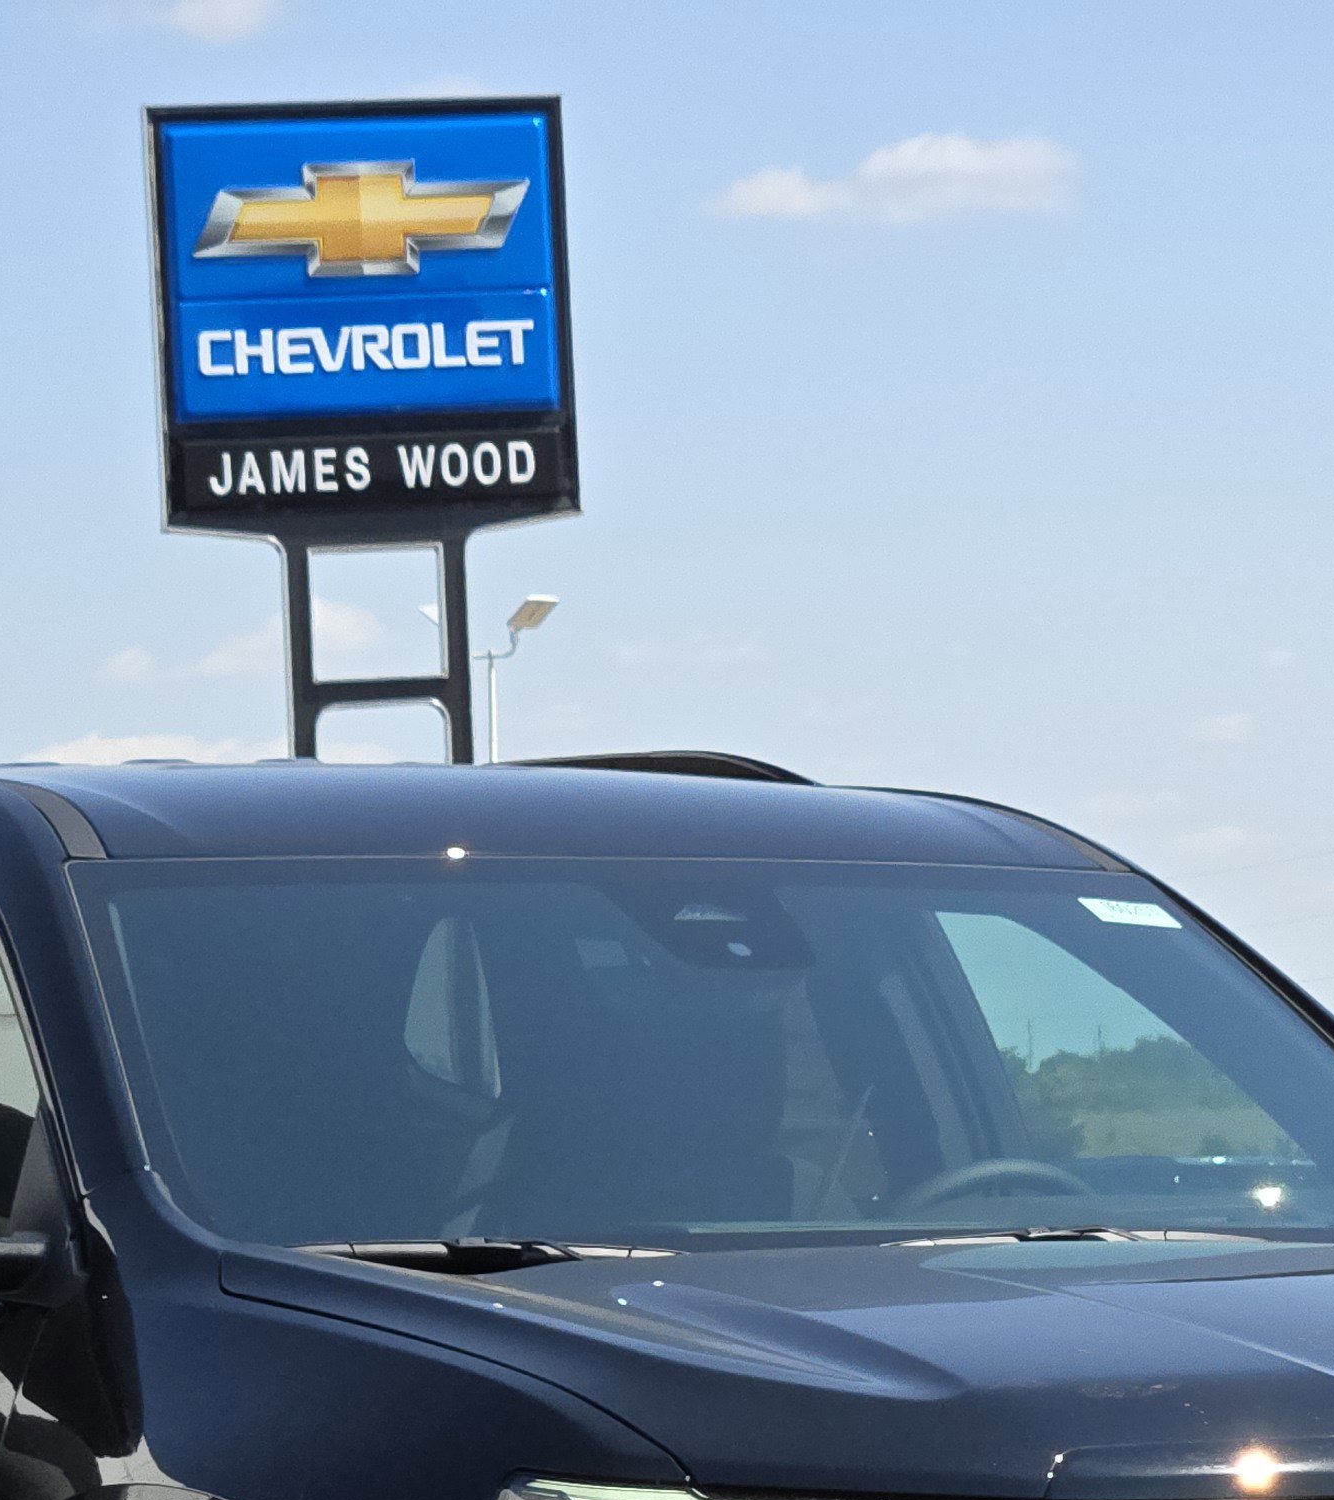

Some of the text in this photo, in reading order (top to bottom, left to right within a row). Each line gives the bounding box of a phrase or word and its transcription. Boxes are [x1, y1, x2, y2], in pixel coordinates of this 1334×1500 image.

[197, 319, 534, 377] CHEVROLET
[208, 439, 537, 496] JAMES WOOD
